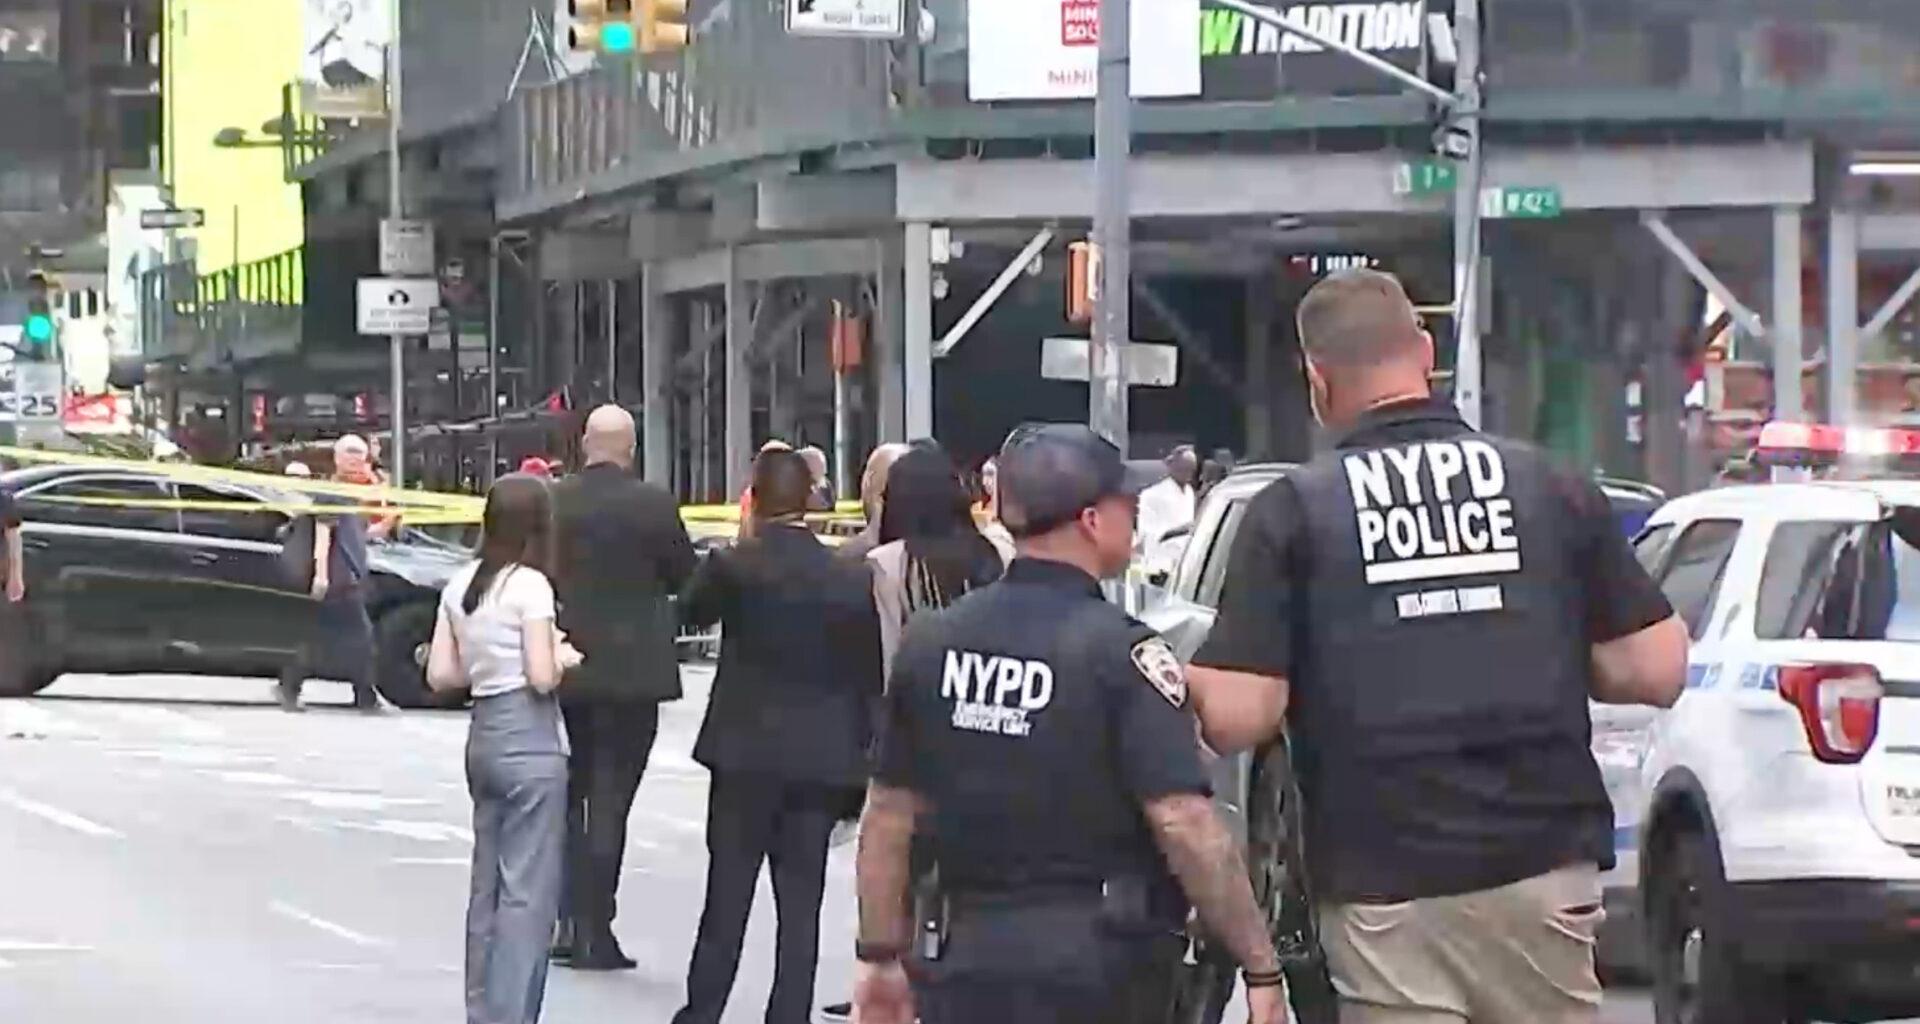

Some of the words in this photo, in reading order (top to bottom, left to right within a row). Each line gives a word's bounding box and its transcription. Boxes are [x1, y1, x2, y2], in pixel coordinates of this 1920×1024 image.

[21, 396, 57, 416] 25
[1344, 440, 1505, 509] NYPD
[1358, 499, 1518, 562] POLICE
[942, 650, 1053, 710] NYPD
